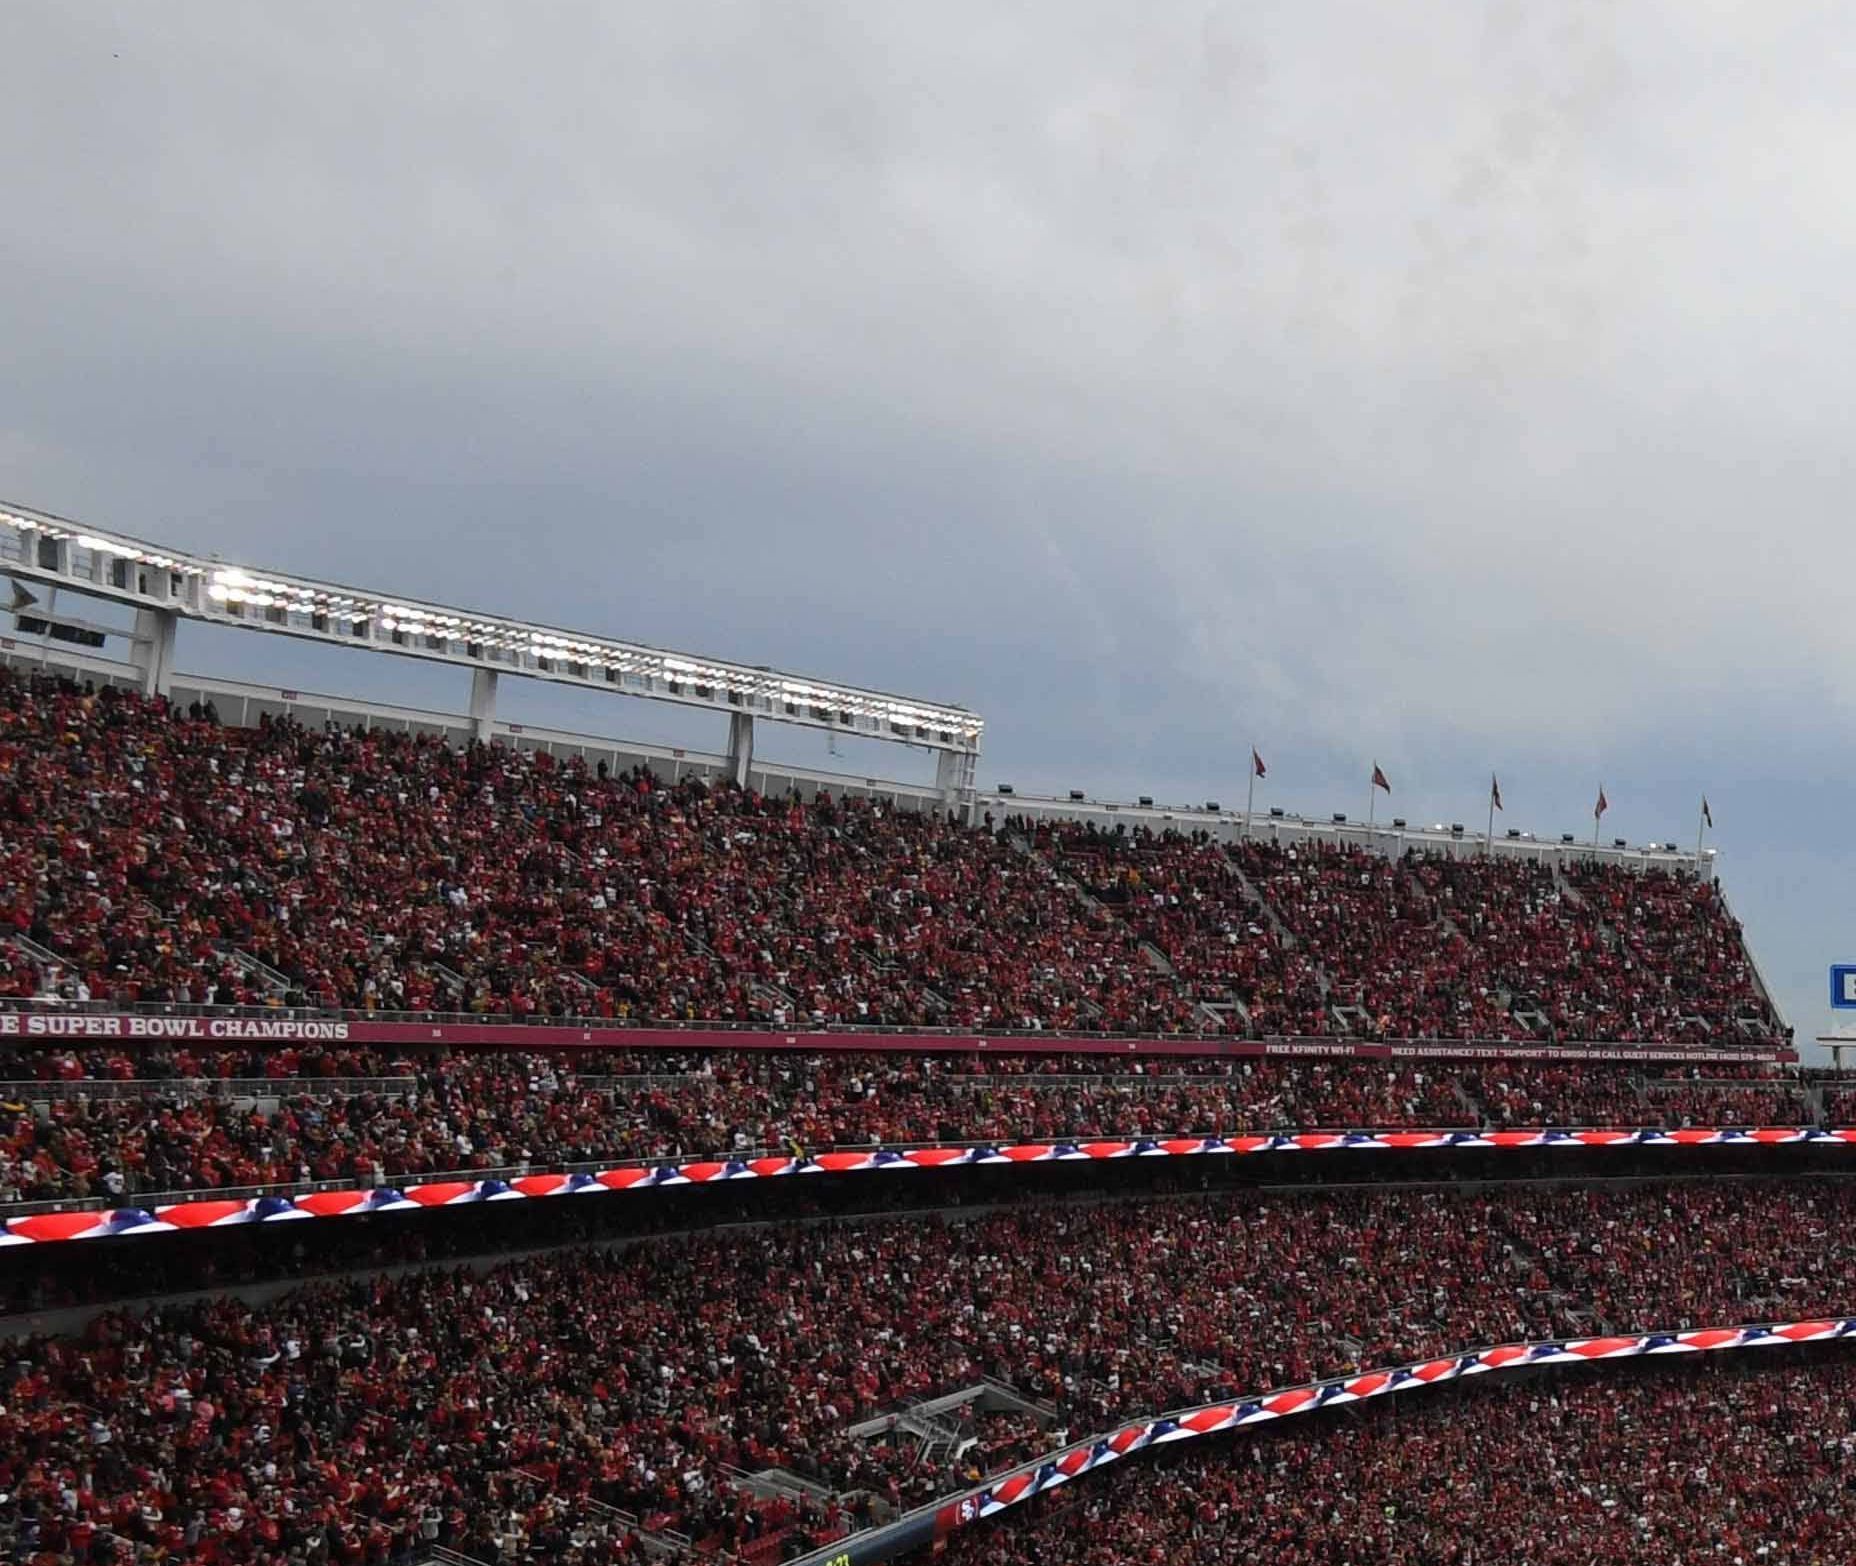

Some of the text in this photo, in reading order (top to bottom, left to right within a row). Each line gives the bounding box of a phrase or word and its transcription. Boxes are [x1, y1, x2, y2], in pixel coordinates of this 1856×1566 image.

[27, 1015, 121, 1036] SUPER
[129, 1017, 204, 1037] BOWL
[210, 1020, 349, 1040] CHAMPIONS
